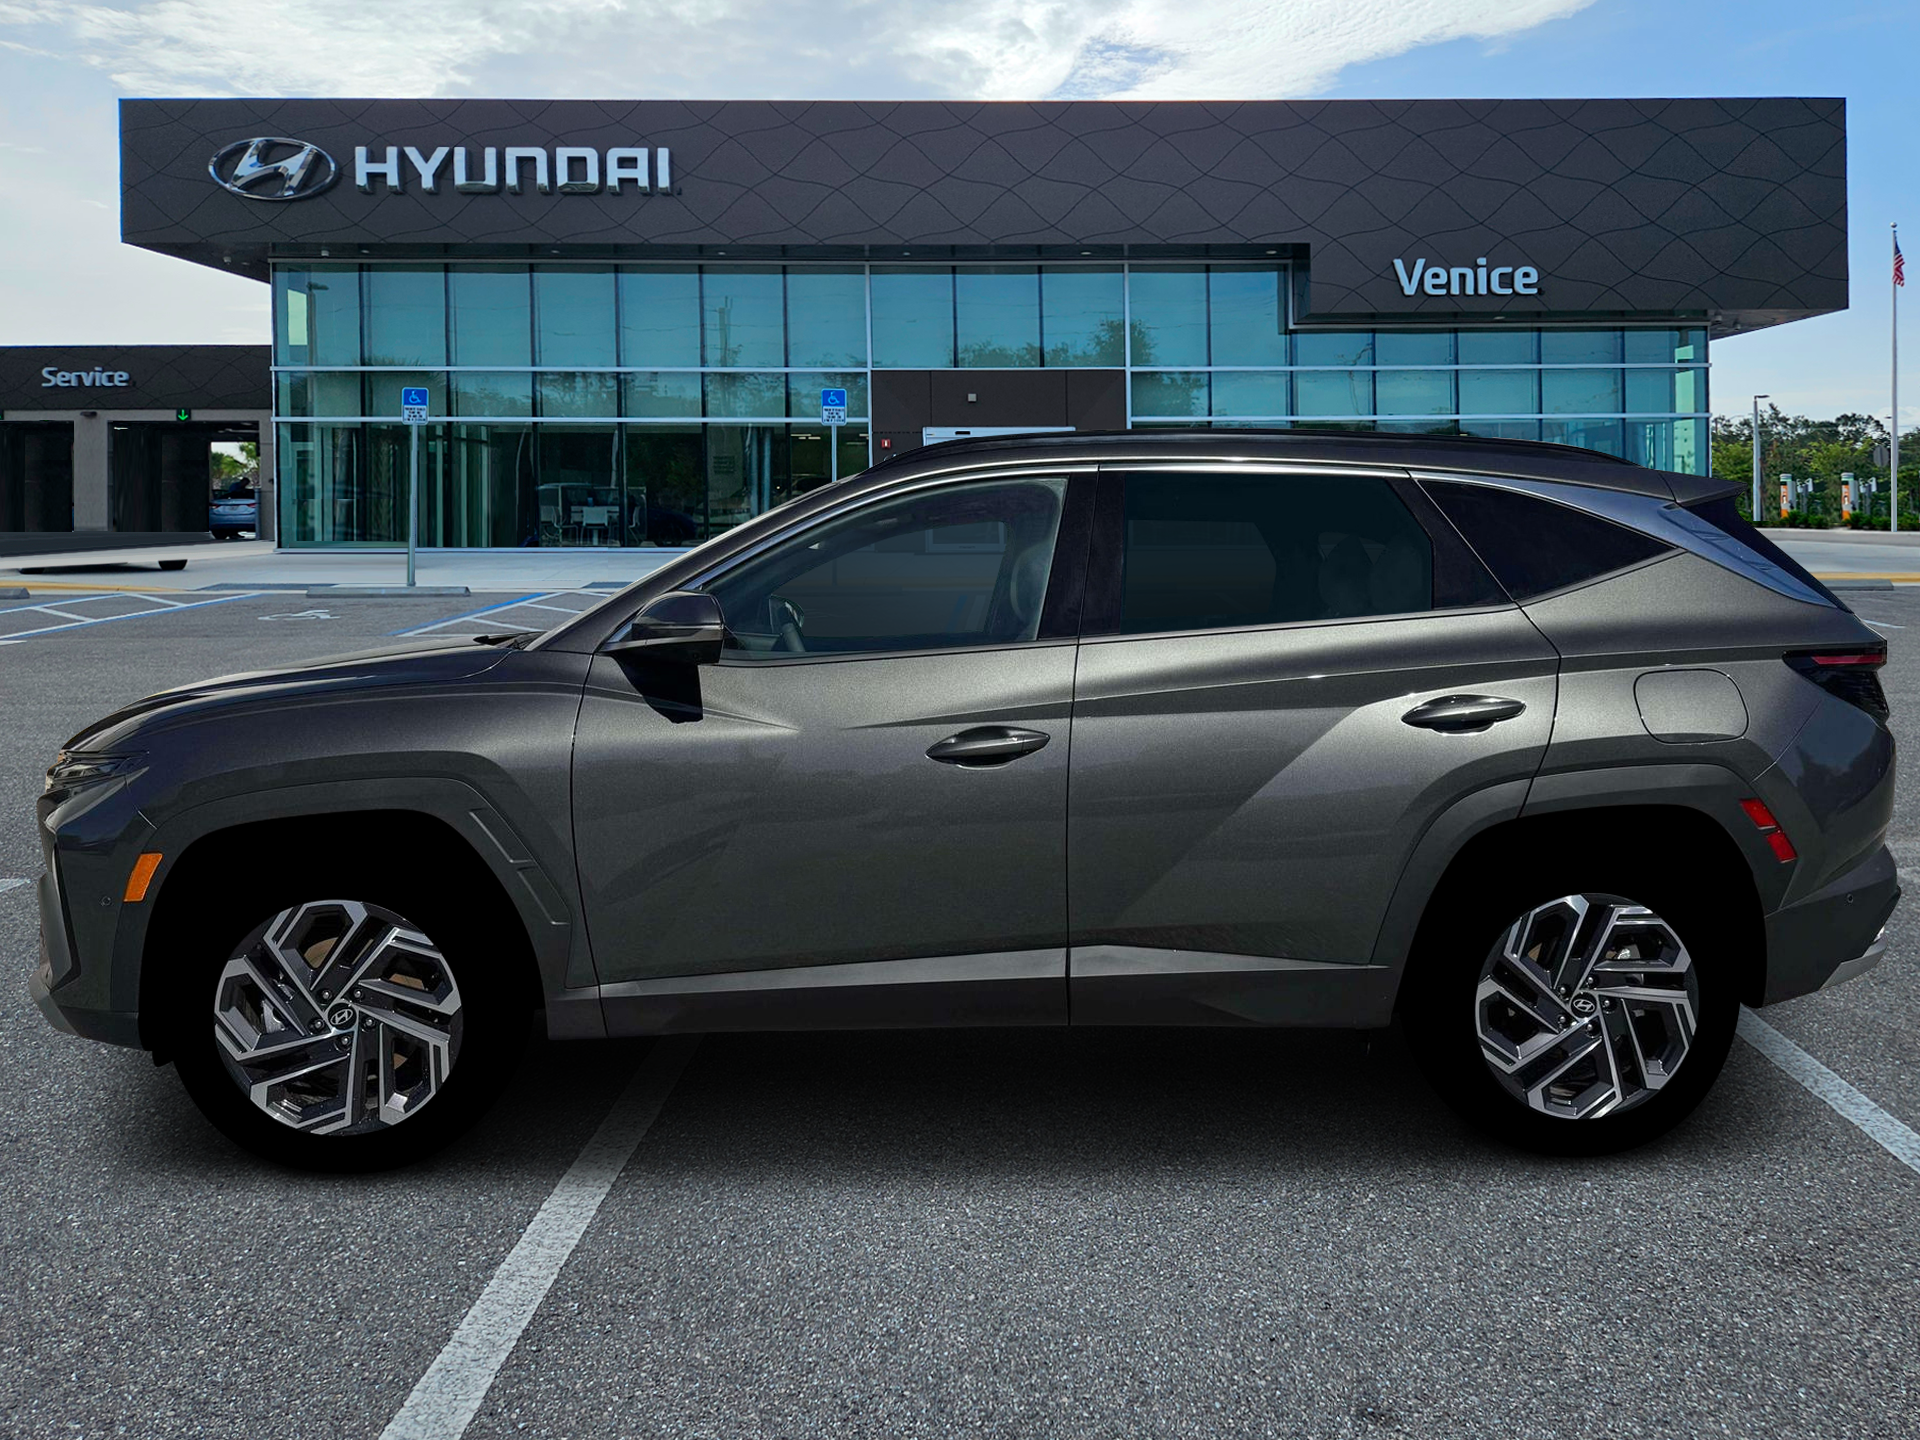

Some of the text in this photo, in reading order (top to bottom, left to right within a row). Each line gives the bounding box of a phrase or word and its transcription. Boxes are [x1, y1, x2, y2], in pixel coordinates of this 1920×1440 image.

[355, 146, 672, 194] HYUNDAI
[1393, 257, 1539, 296] Venice
[41, 366, 130, 388] Service
